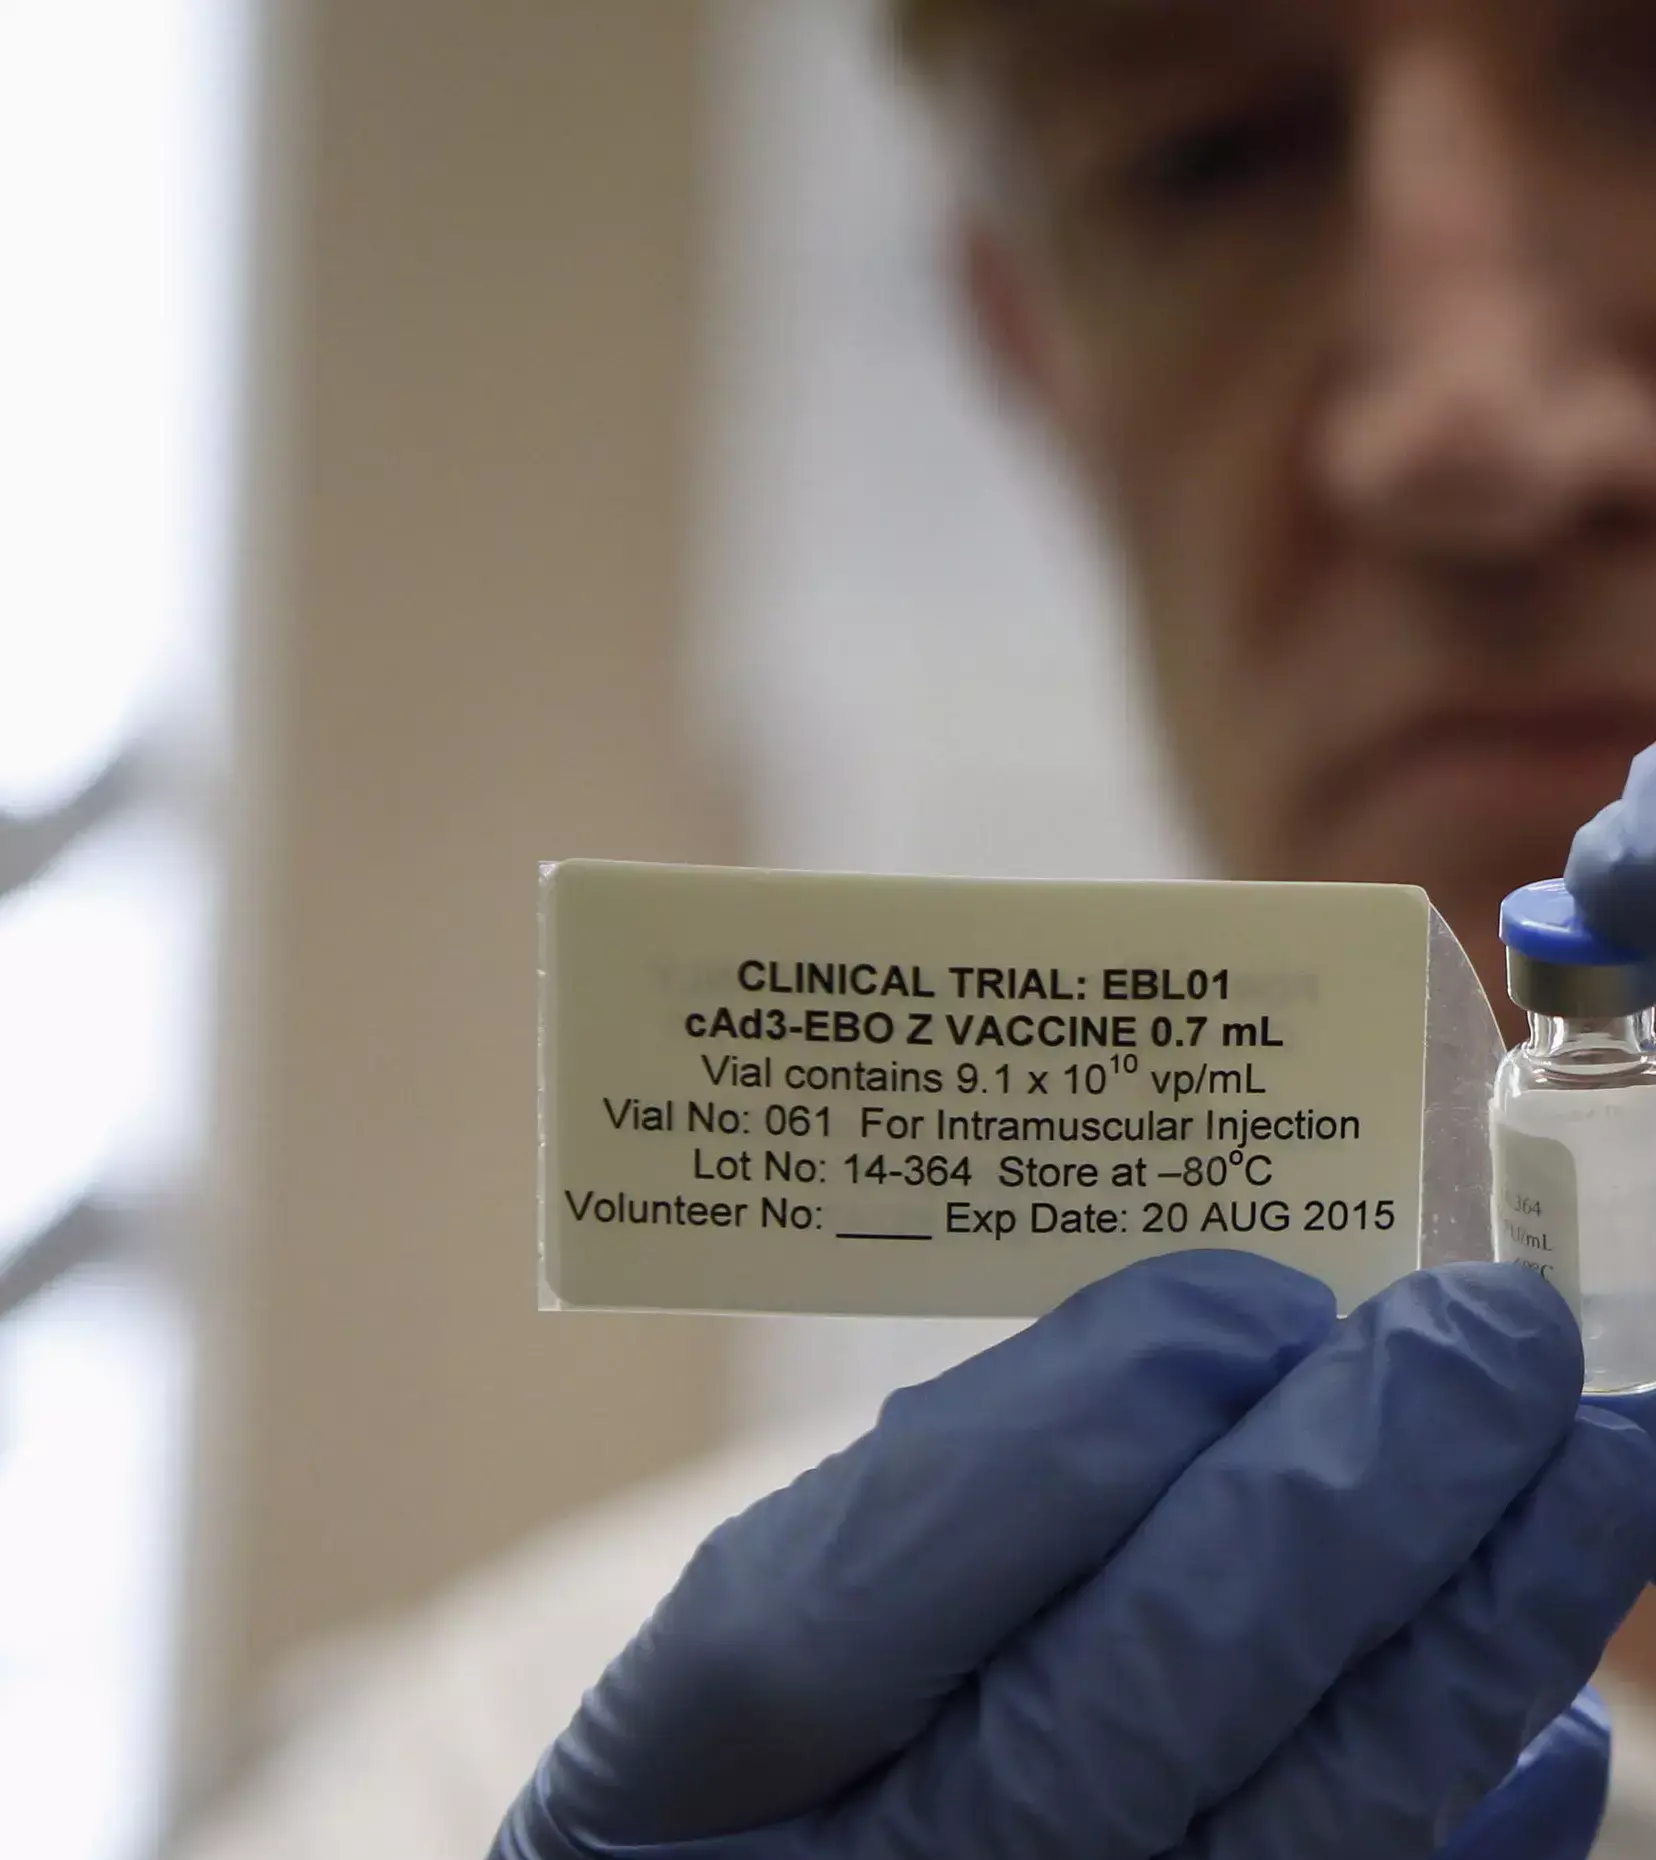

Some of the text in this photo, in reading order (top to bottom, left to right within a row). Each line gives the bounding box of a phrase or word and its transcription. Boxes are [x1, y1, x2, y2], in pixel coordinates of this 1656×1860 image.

[737, 959, 936, 999] CLINICAL
[948, 966, 1087, 1001] TRIAL:
[1102, 968, 1231, 1001] EBL01
[684, 1006, 1285, 1048] cAd3-EBO Z VACCINE 0.7 mL
[700, 1054, 772, 1088] Vial
[784, 1060, 944, 1094] contains
[956, 1062, 1010, 1094] 9.1
[1027, 1071, 1050, 1095] x
[1150, 1062, 1267, 1103] vp/mL
[602, 1097, 1361, 1149] Vial No: 061 For Intramuscular Injection
[694, 1147, 752, 1182] Lot
[764, 1150, 827, 1184] No:
[844, 1153, 974, 1187] 14-364
[998, 1155, 1100, 1188] Store
[1111, 1157, 1149, 1188] at
[564, 1189, 1396, 1241] Volunteer No: Exp Date: 20 AUG 2015
